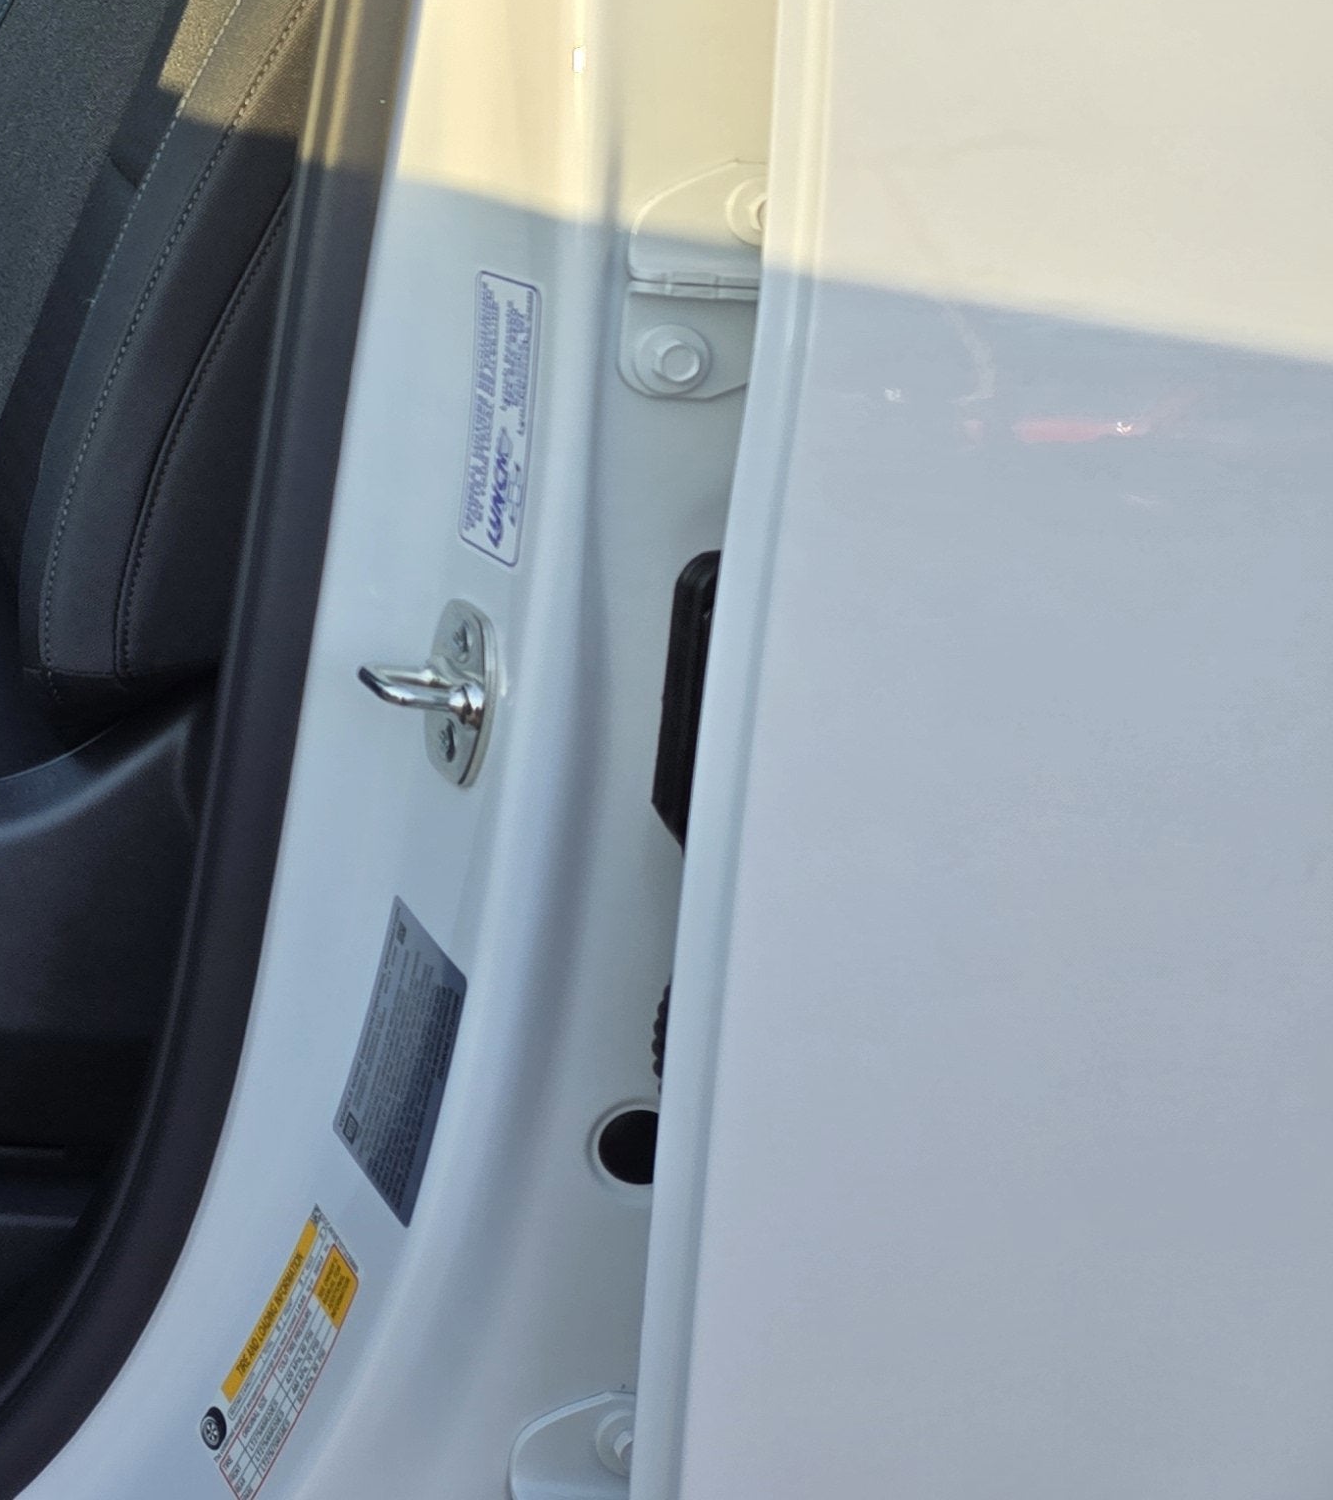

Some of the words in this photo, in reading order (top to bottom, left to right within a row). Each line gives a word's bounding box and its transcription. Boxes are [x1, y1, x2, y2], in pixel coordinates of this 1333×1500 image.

[236, 1353, 249, 1377] TIRE
[246, 1336, 259, 1359] AND
[255, 1302, 277, 1341] LOADING
[271, 1252, 303, 1305] INFORMATION
[278, 1353, 289, 1373] COLD
